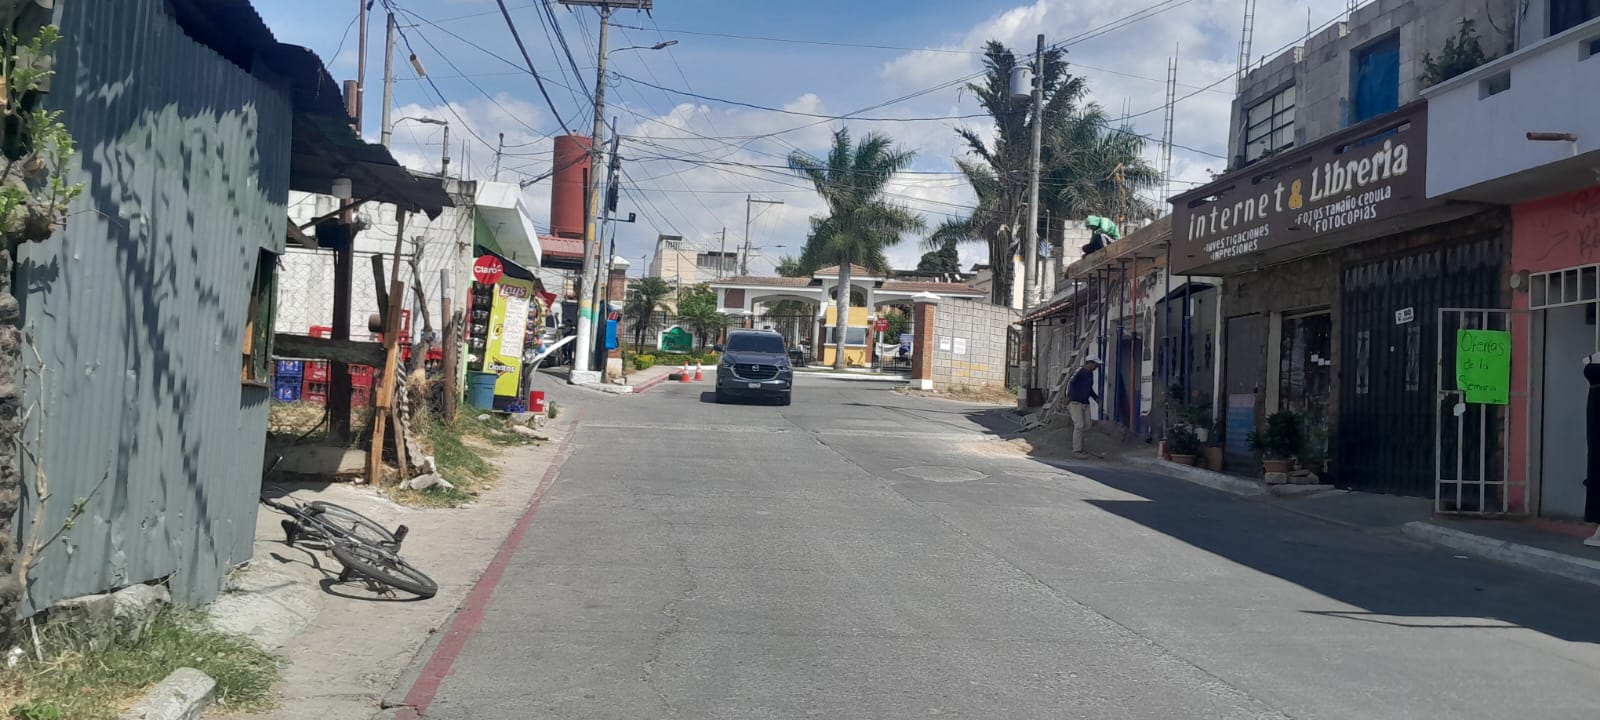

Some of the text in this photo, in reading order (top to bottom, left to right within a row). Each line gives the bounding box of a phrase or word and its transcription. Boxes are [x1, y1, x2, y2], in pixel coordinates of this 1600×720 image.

[1188, 139, 1408, 241] internet & Libreria
[474, 264, 498, 274] Claro
